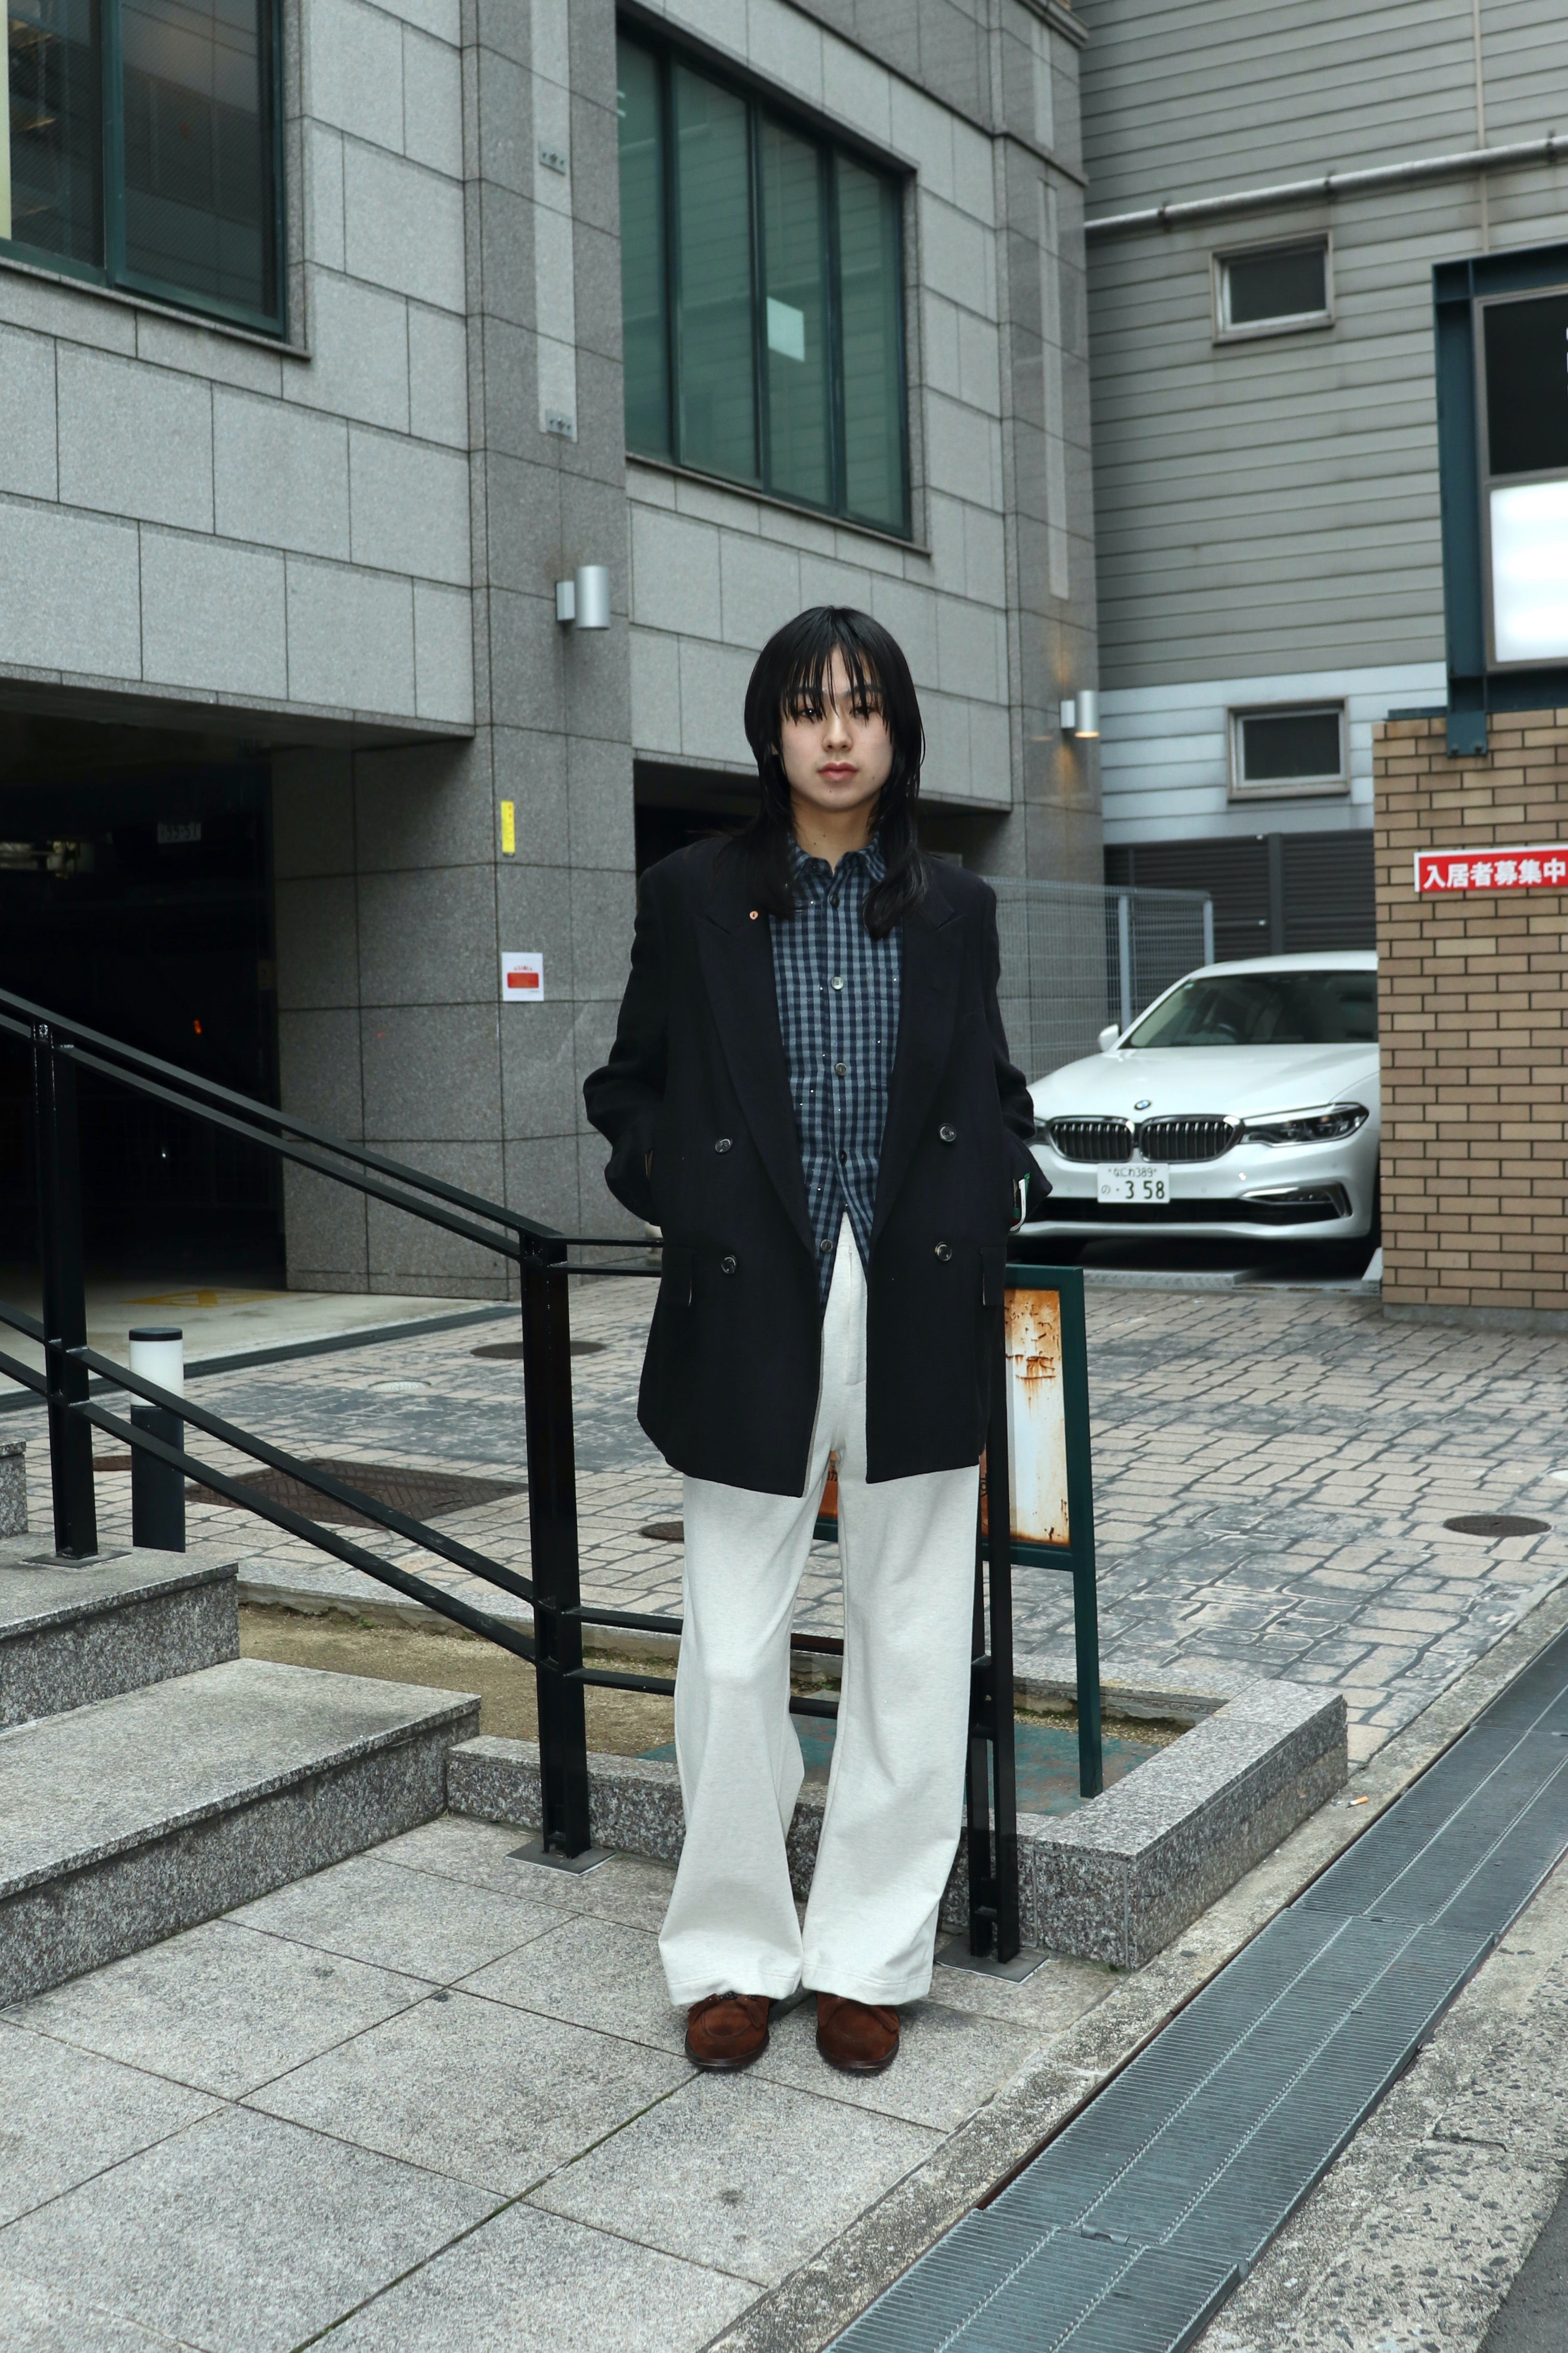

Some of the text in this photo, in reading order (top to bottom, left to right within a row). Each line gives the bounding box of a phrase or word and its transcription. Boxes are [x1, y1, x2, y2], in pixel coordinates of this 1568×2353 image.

[1424, 857, 1566, 889] 入居者募集中
